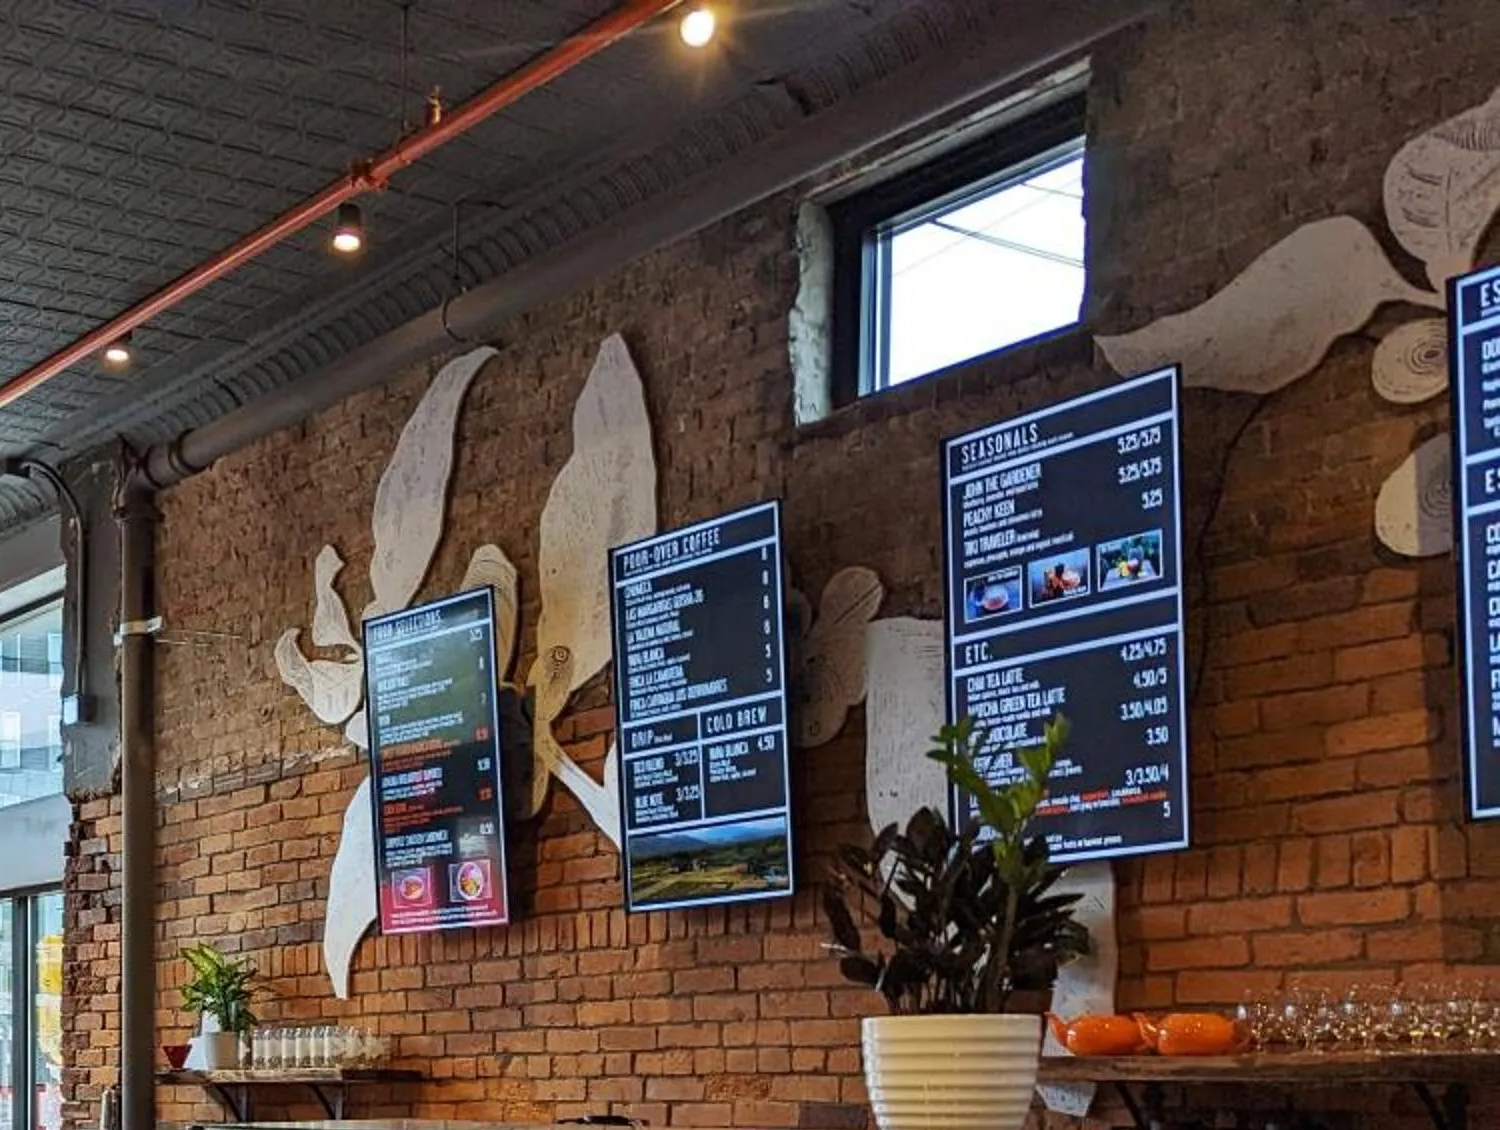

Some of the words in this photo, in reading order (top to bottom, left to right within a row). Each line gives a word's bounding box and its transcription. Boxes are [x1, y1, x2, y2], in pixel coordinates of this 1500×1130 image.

[961, 423, 1038, 464] SEASONALS
[683, 528, 721, 553] COFFEE
[965, 642, 994, 665] ETC.
[706, 715, 732, 734] COLD
[737, 706, 768, 728] BREW
[632, 730, 654, 749] DRIP
[1162, 800, 1171, 818] 5
